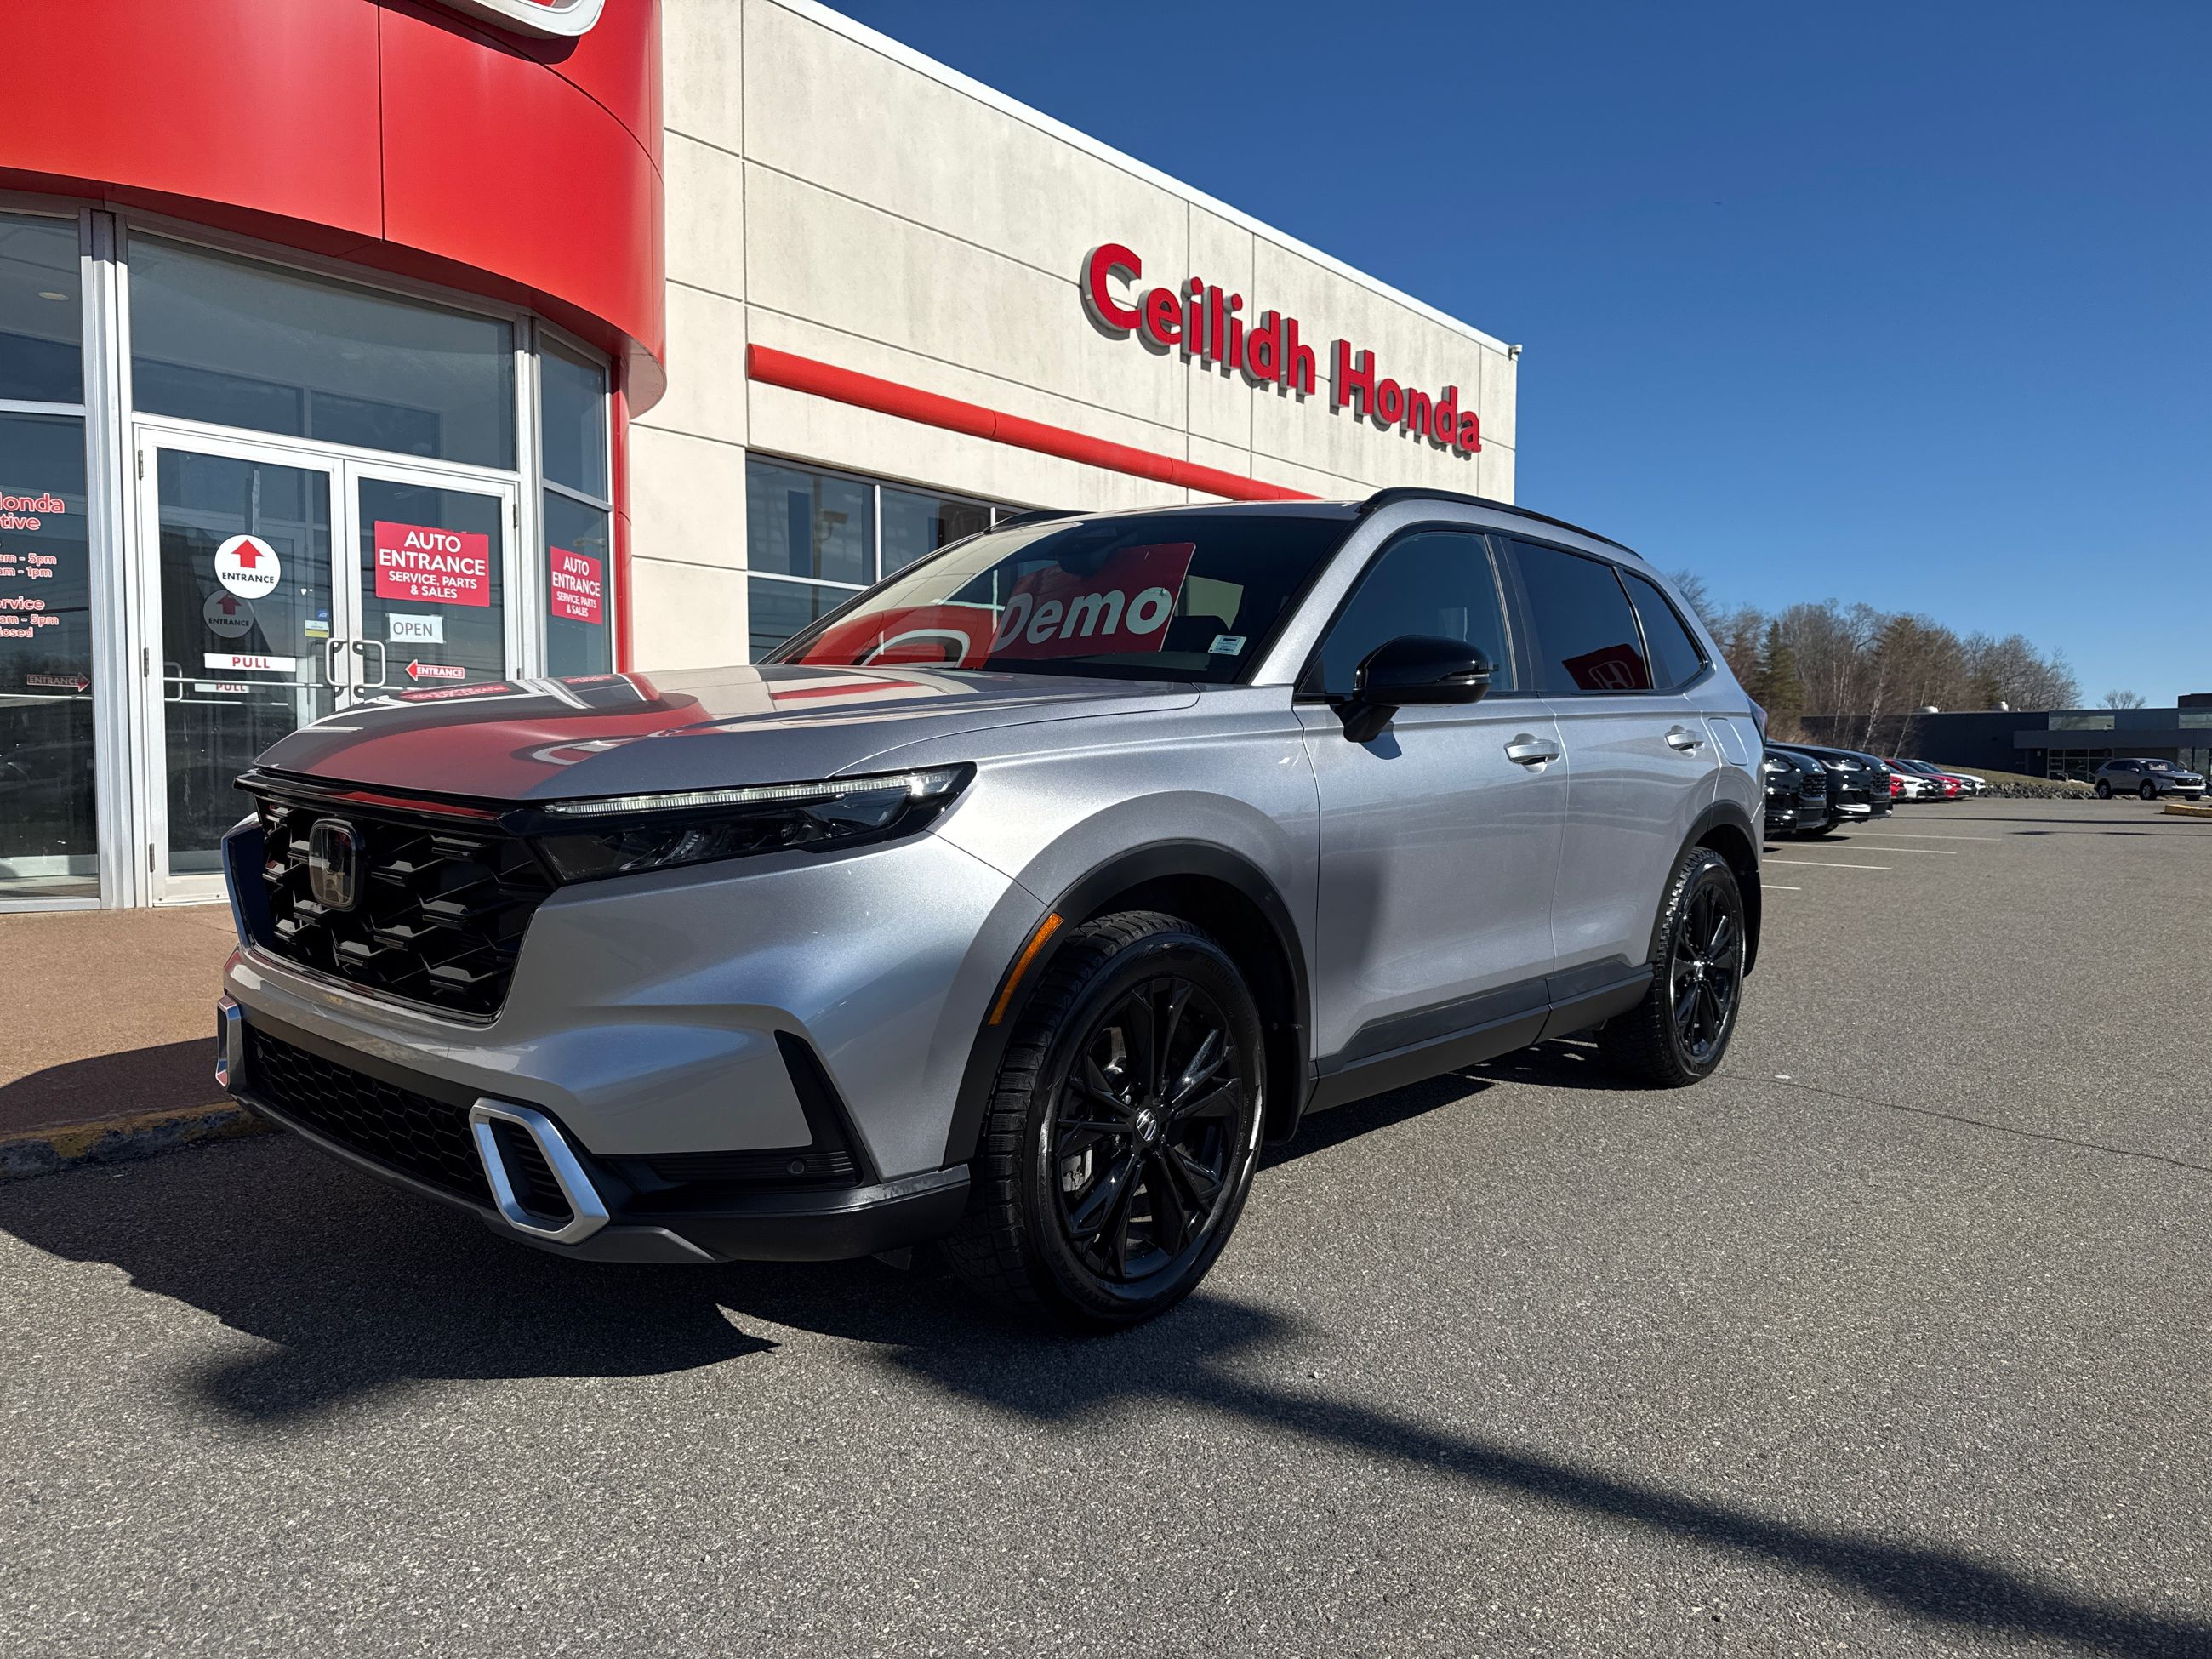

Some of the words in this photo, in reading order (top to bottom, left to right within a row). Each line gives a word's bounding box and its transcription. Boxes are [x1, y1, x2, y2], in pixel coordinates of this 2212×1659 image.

[1080, 243, 1315, 402] Ceilidh
[1331, 339, 1482, 456] Honda
[404, 531, 461, 553] AUTO
[28, 553, 57, 567] 5pm
[379, 548, 486, 576] ENTRANCE
[563, 556, 590, 576] AUTO
[26, 567, 53, 579] 1pm
[222, 572, 274, 584] ENTRANCE
[389, 571, 440, 587] SERVICE,
[442, 576, 477, 590] PARTS
[552, 571, 601, 597] ENTRANCE
[410, 584, 419, 596] &
[421, 585, 458, 599] SALES
[0, 596, 45, 610] rvice
[30, 614, 59, 627] 5pm
[208, 618, 249, 627] ENTRANCE
[989, 587, 1172, 653] Demo
[393, 622, 433, 636] OPEN
[232, 656, 270, 669] PULL
[416, 666, 463, 676] ENTRANCE
[29, 676, 78, 687] ENTRANCE
[216, 683, 246, 692] PULL
